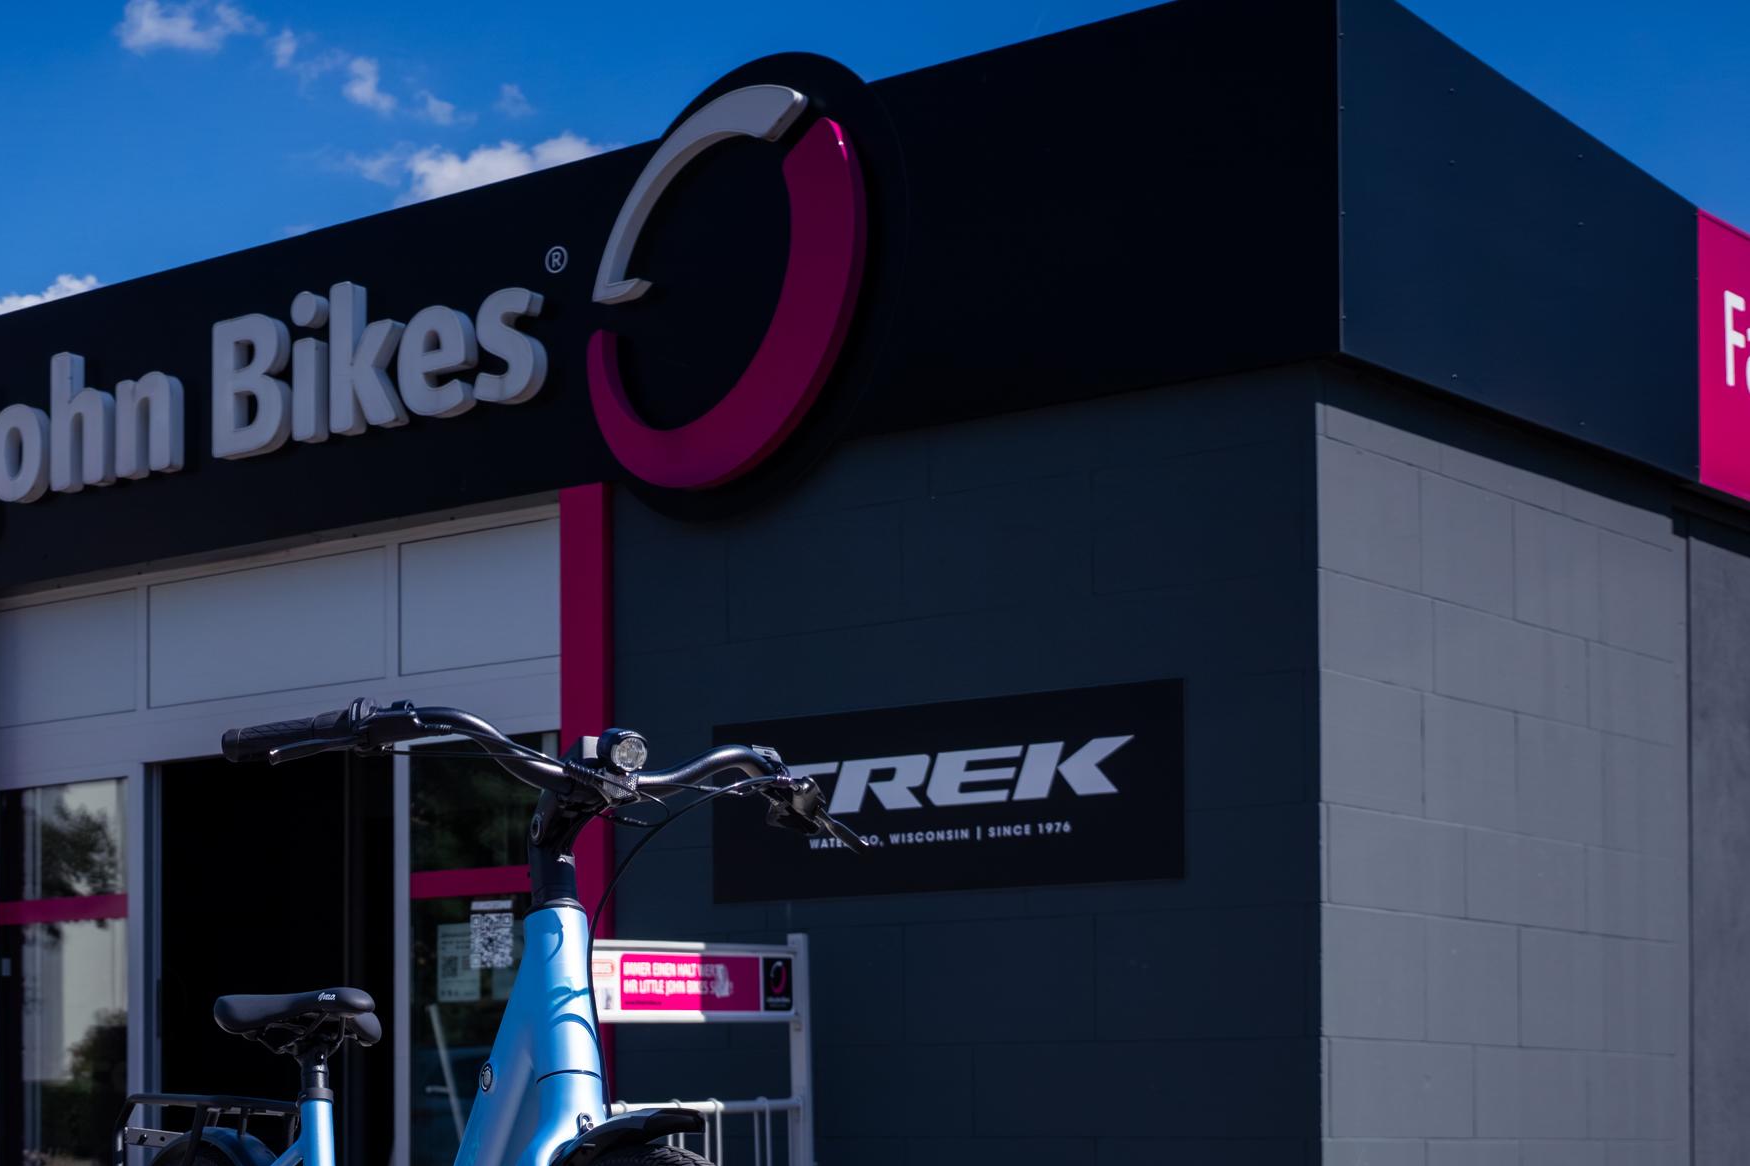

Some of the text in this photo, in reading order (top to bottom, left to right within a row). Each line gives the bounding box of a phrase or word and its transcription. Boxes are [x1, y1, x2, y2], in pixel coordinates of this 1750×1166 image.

[212, 280, 548, 460] Bikes
[1723, 289, 1750, 394] F
[889, 830, 970, 844] WISCONSIN
[987, 823, 1031, 838] SINCE
[1037, 821, 1071, 834] 1976
